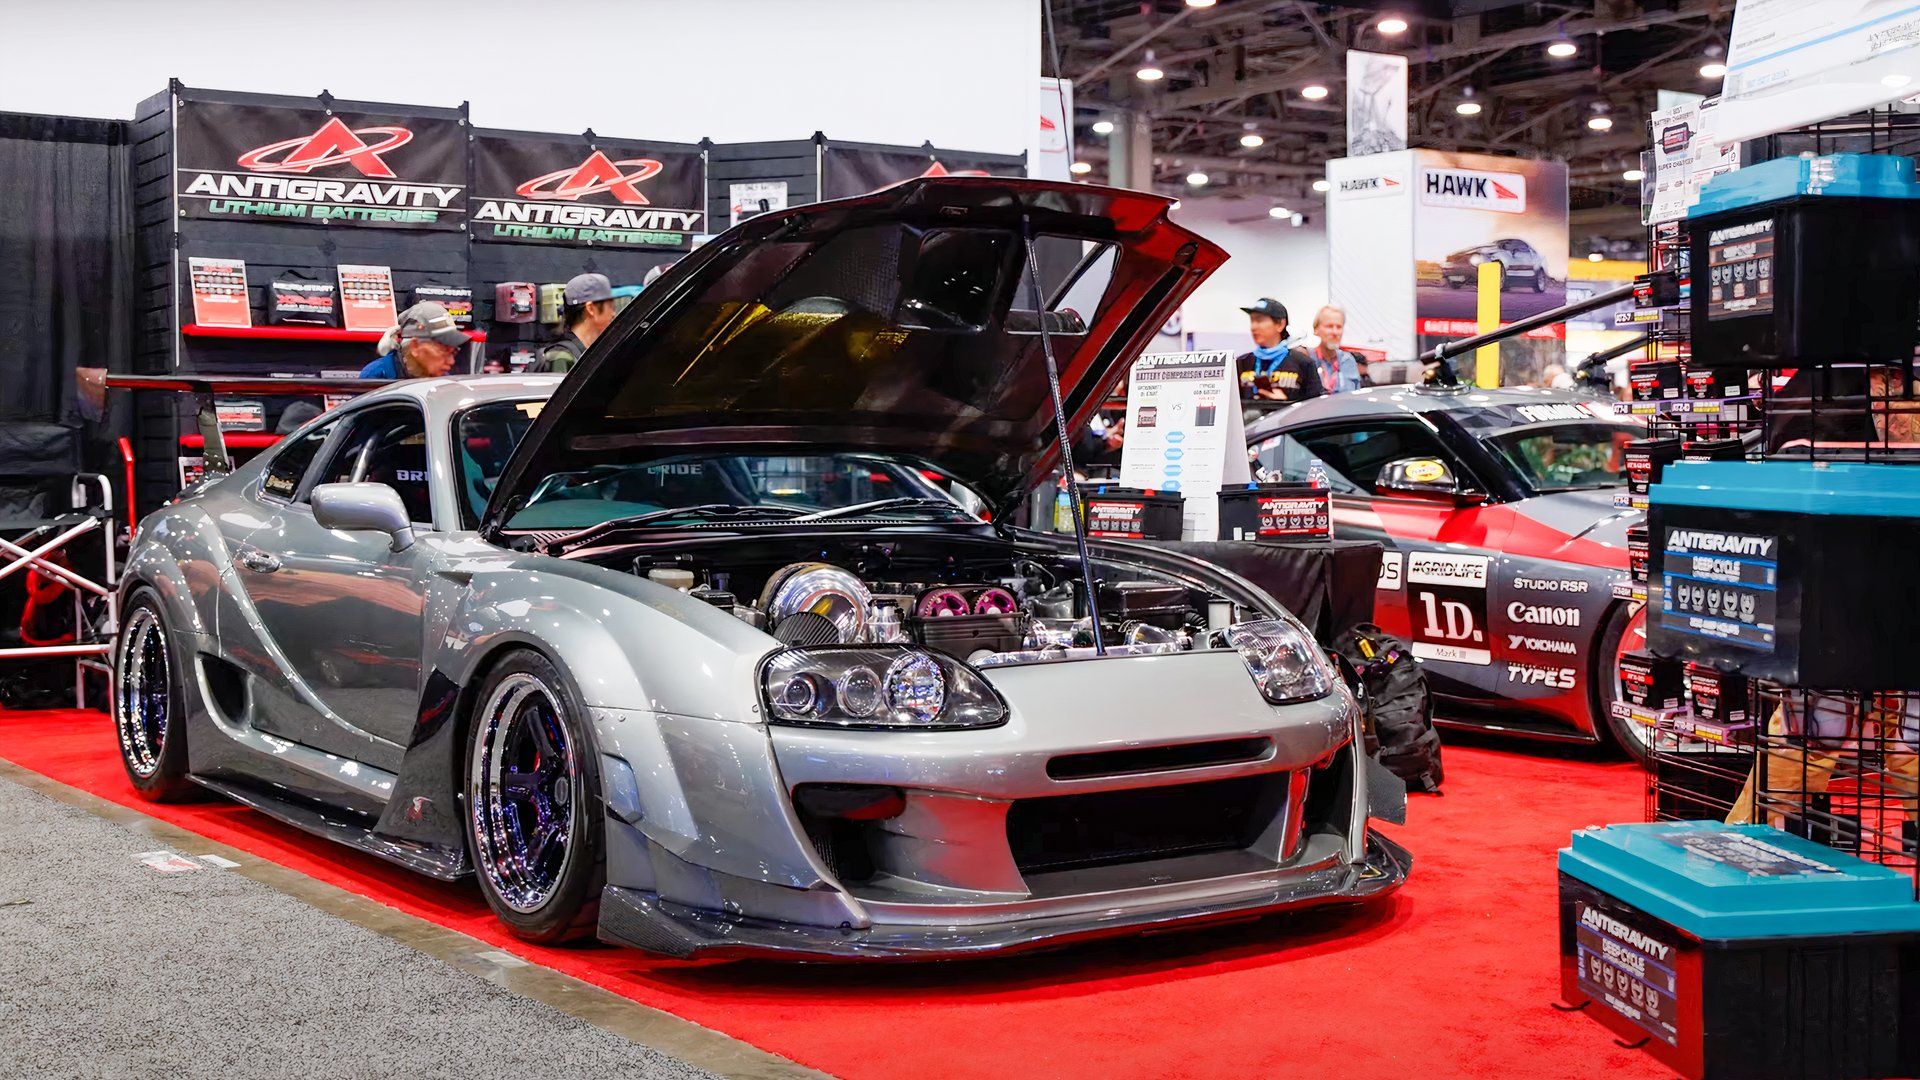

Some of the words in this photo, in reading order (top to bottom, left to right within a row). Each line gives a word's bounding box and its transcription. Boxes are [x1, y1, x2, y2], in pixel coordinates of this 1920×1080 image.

[185, 174, 462, 208] ANTIGRAVITY
[1426, 173, 1488, 199] HAWK
[208, 199, 307, 218] LITHIUM
[311, 206, 438, 223] BATTERIES
[474, 201, 702, 231] ANTIGRAVITY
[494, 224, 575, 240] LITHIUM
[578, 228, 683, 246] BATTERIES
[1137, 352, 1227, 366] ANTIGRAVITY
[396, 469, 428, 481] BRI
[1668, 530, 1773, 557] ANTIGRAVITY
[1412, 561, 1483, 579] #GRIDLIFE
[1513, 577, 1559, 591] STUDIO
[1560, 580, 1588, 593] RSR
[1507, 601, 1580, 627] Canon
[1434, 648, 1457, 658] Mark
[1524, 638, 1577, 655] YOKOHAMA
[1581, 906, 1669, 961] ANTIGRAVITY
